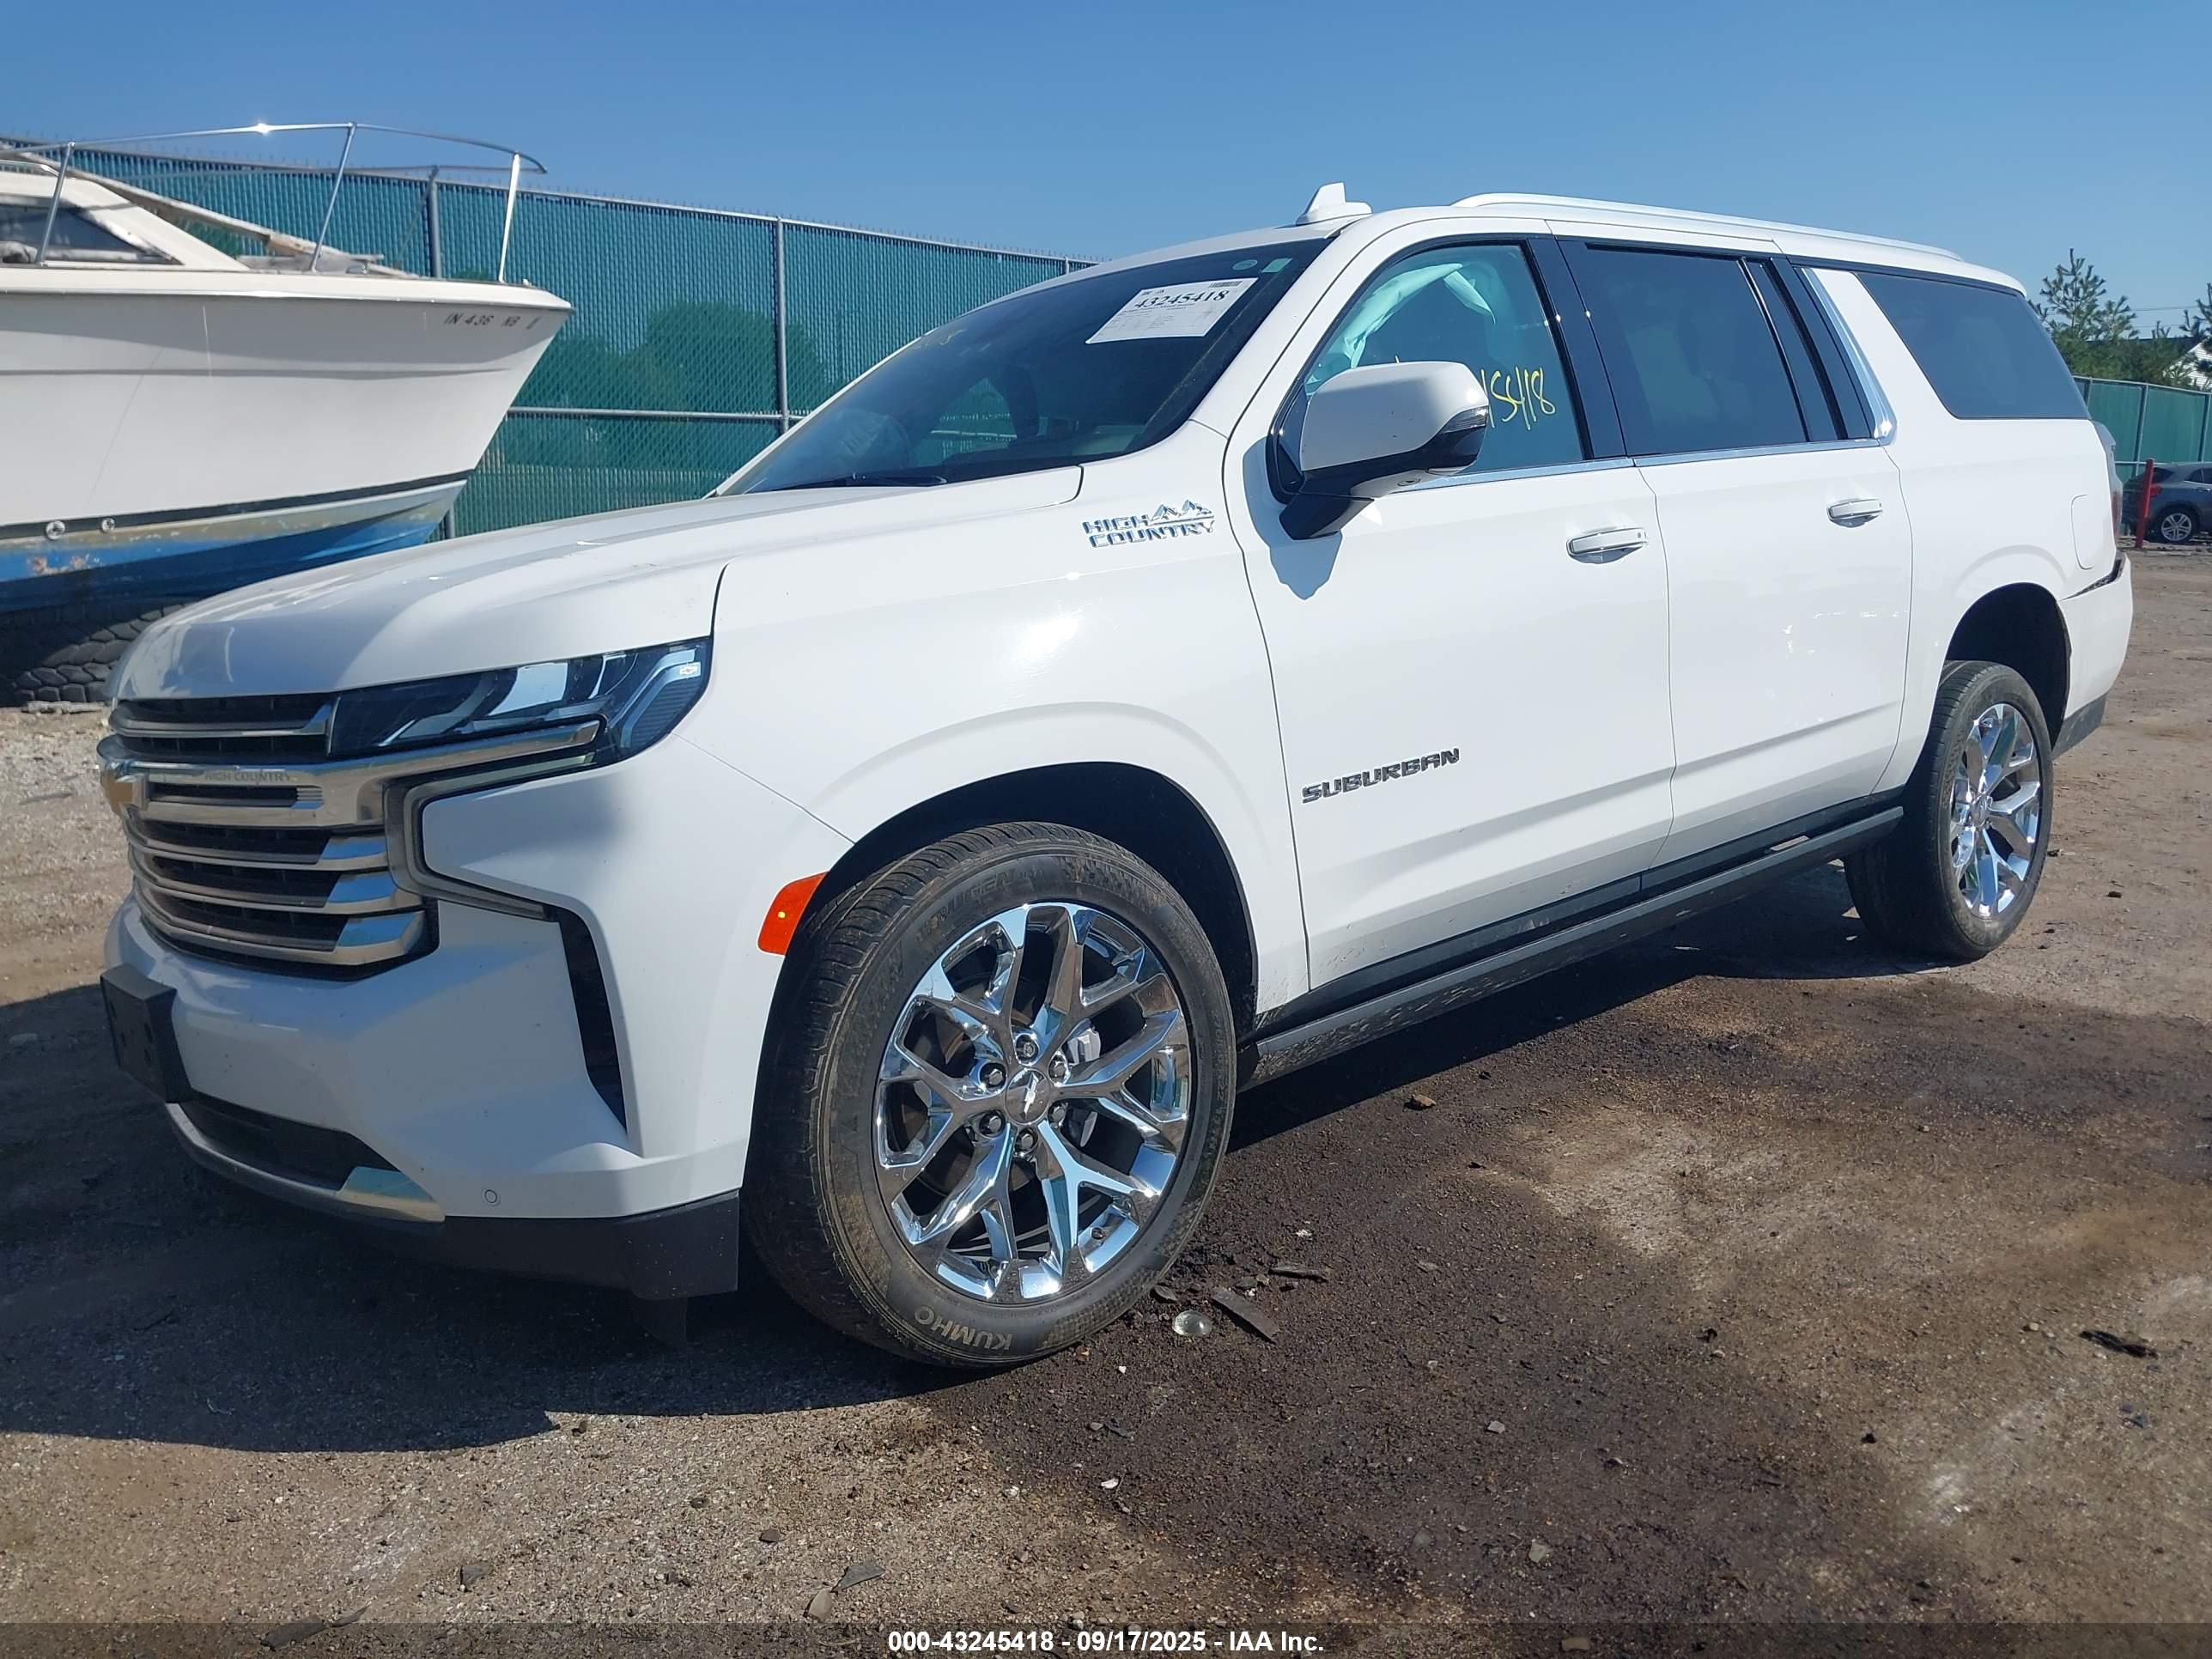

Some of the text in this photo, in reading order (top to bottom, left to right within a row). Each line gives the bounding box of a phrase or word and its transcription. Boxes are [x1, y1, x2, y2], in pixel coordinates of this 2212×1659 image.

[1133, 289, 1231, 309] 43245418
[1082, 514, 1151, 534] HIGH
[1089, 520, 1215, 548] COUNTRY
[205, 772, 291, 782] HIGH COUNTRY
[1302, 747, 1460, 805] SUBURBAN
[914, 1305, 1013, 1351] KUMHO
